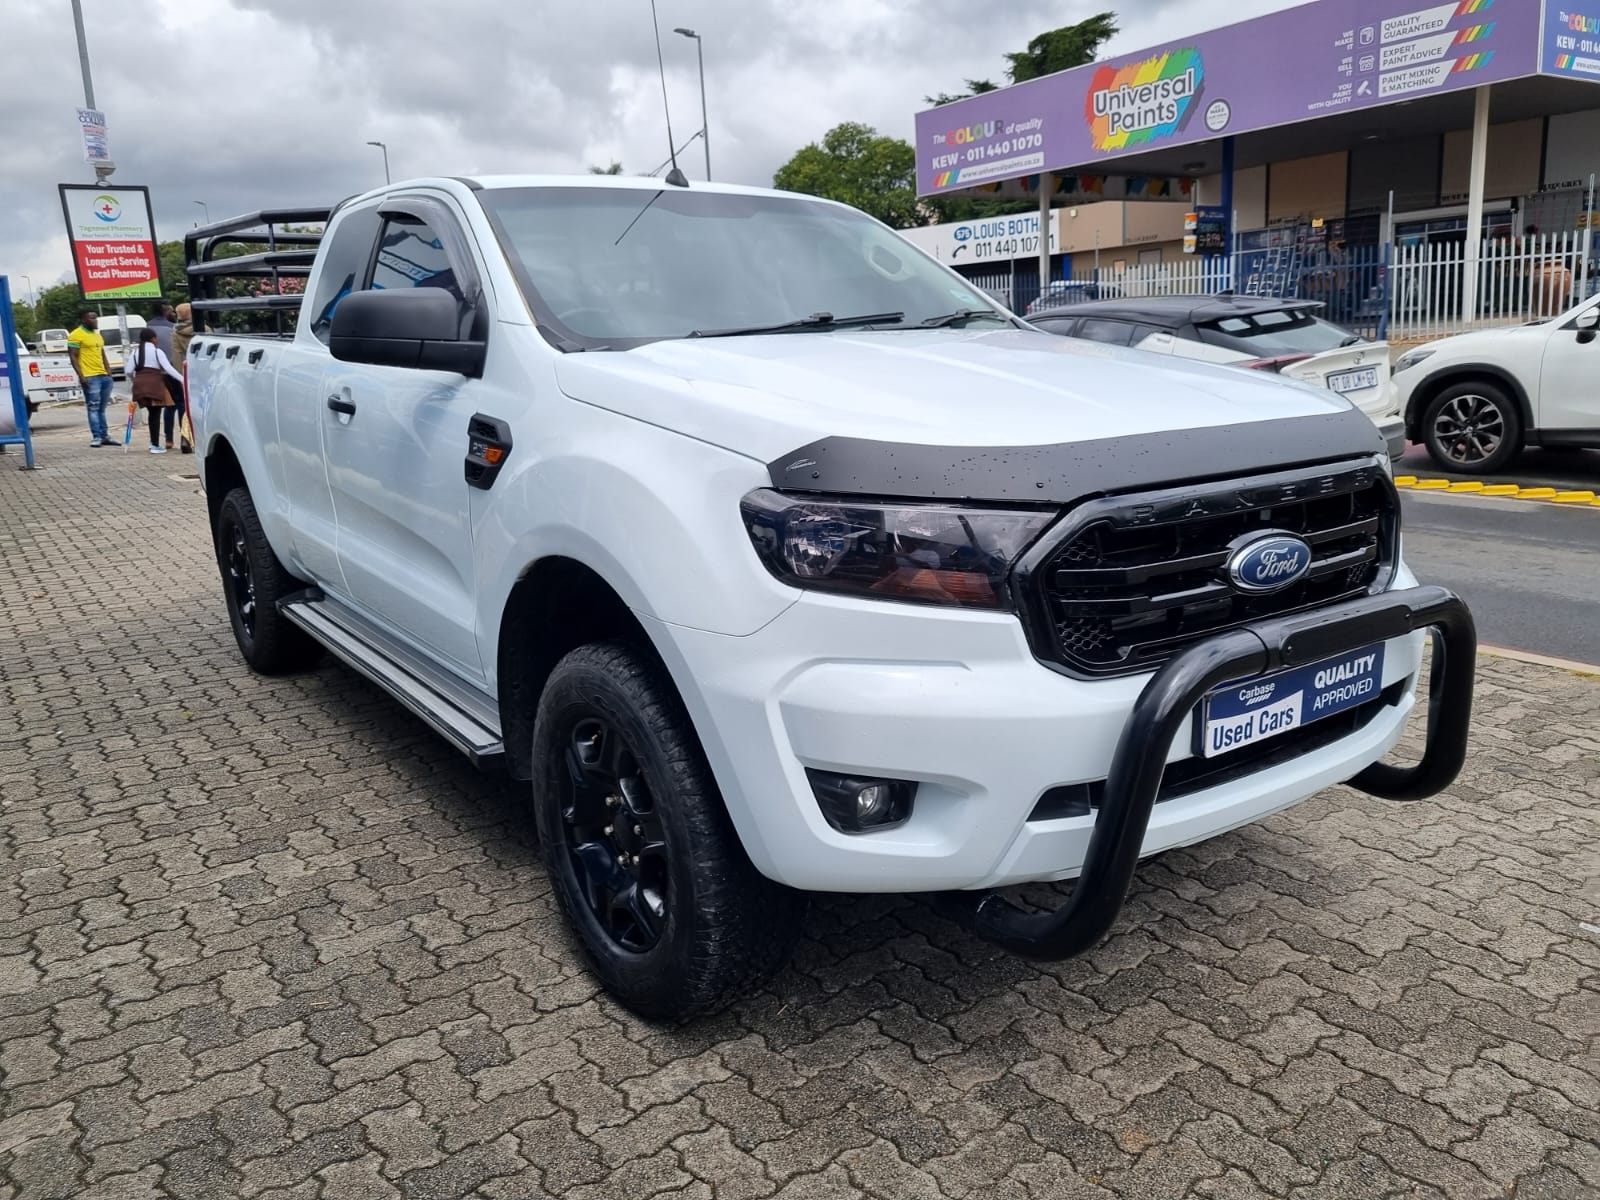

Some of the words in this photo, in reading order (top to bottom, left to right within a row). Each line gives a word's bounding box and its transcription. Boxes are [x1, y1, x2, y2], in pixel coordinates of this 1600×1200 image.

[1384, 15, 1421, 31] QUALITY
[1559, 11, 1569, 22] The
[1342, 30, 1354, 38] WE
[1383, 19, 1444, 40] GUARANTEED
[1334, 38, 1354, 47] MAKE
[1383, 44, 1417, 57] EXPERT
[1556, 35, 1576, 50] KEW
[1581, 40, 1593, 53] 011
[1341, 56, 1353, 65] WE
[1383, 55, 1408, 66] PAINT
[1409, 47, 1443, 61] ADVICE
[1382, 73, 1408, 85] PAINT
[1408, 66, 1441, 79] MIXING
[1095, 70, 1193, 114] Universal
[1332, 89, 1353, 99] PAINT
[1338, 83, 1353, 91] YOU
[1389, 79, 1435, 92] MATCHING
[1307, 102, 1325, 110] WITH
[1325, 96, 1352, 108] QUALITY
[1110, 99, 1176, 133] Paints
[932, 134, 946, 145] The
[946, 120, 1004, 146] COLOUR
[1005, 122, 1015, 135] of
[1015, 118, 1043, 134] quality
[932, 152, 958, 170] KEW
[966, 145, 985, 162] 011
[986, 141, 1010, 158] 440
[1012, 133, 1043, 151] 1070
[973, 221, 1005, 240] LOUIS
[86, 244, 105, 254] Your
[105, 244, 136, 254] Trusted
[137, 244, 144, 254] &
[975, 242, 992, 257] 011
[995, 239, 1018, 256] 440
[85, 257, 117, 268] Longest
[119, 257, 150, 268] Serving
[88, 269, 110, 279] Local
[111, 269, 151, 280] Pharmacy
[1256, 547, 1299, 581] Ford
[1314, 653, 1376, 689] QUALITY
[1239, 683, 1275, 700] Carbase
[1313, 677, 1373, 711] APPROVED
[1213, 715, 1253, 750] Used
[1258, 707, 1294, 735] Cars
